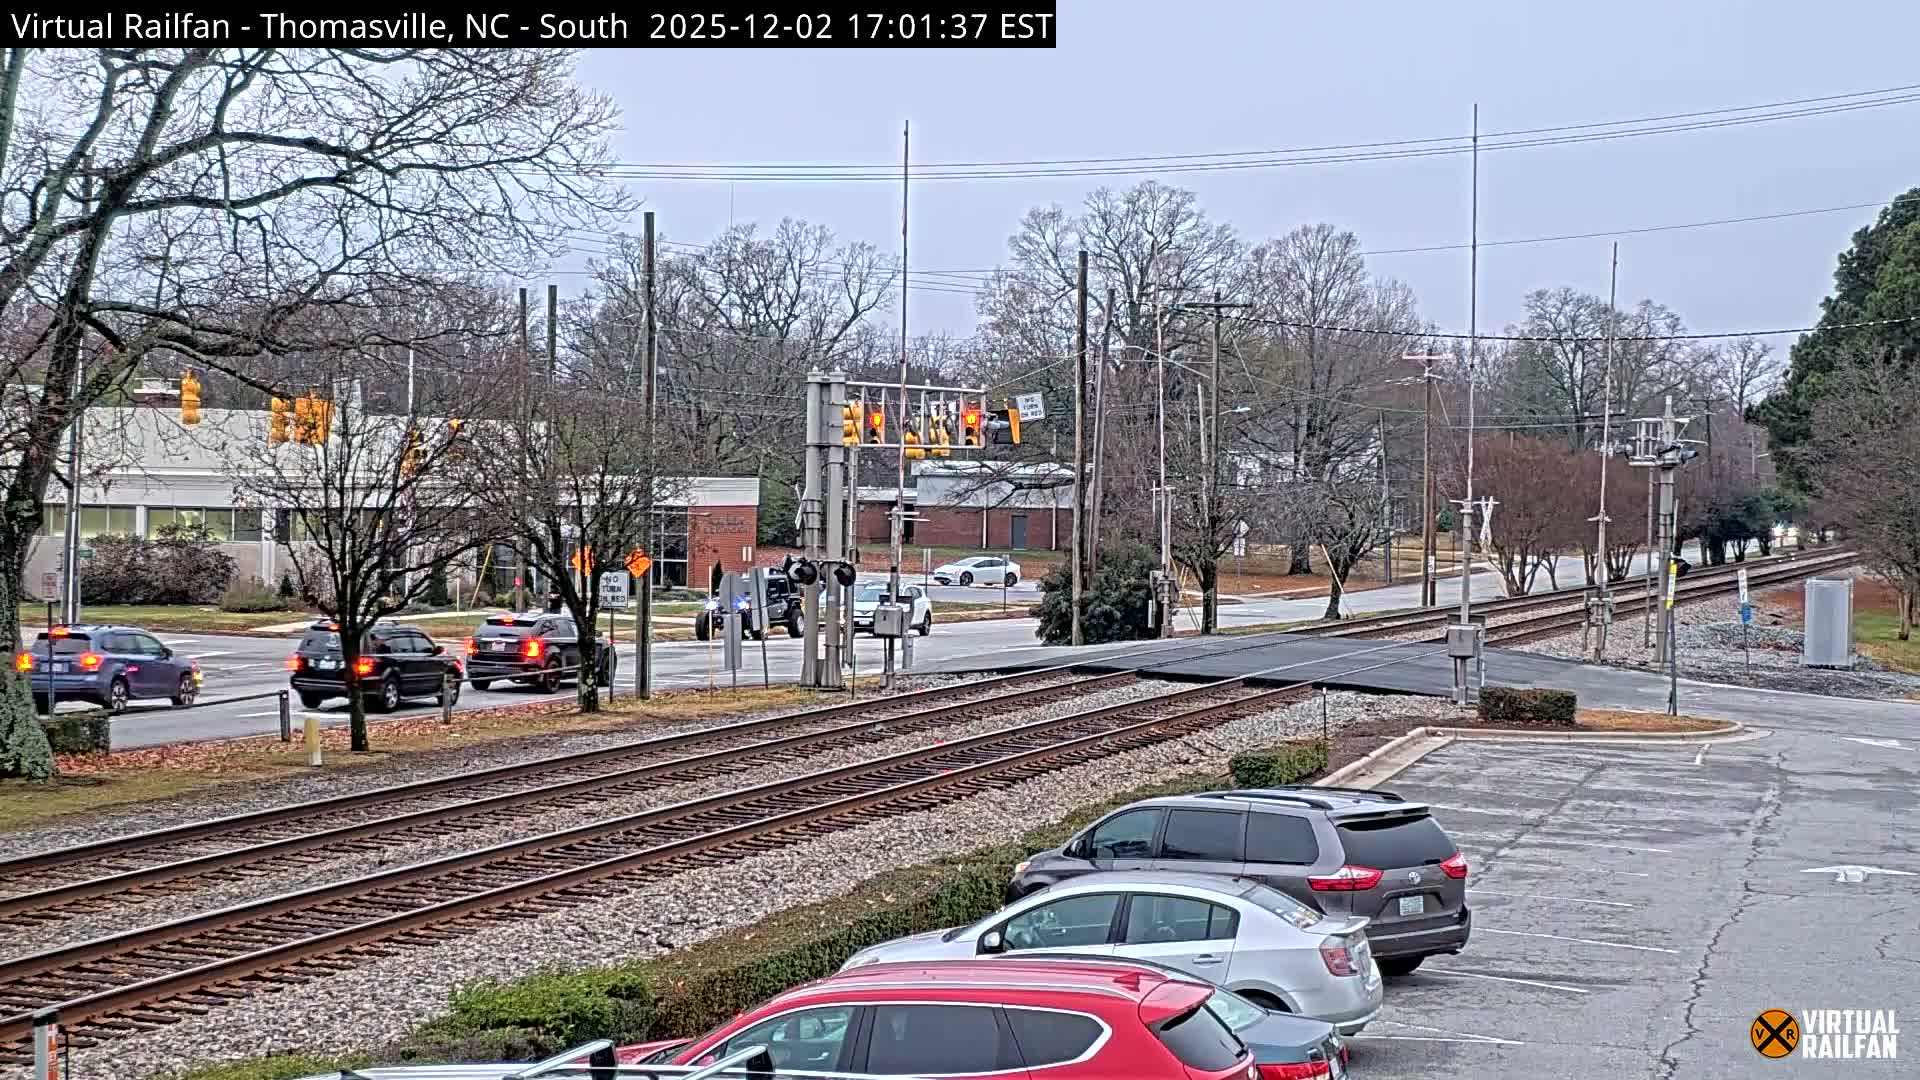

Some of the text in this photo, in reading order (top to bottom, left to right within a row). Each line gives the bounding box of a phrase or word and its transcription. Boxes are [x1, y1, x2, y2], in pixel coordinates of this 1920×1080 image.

[605, 575, 619, 583] NO
[602, 585, 622, 593] TURN
[611, 595, 626, 603] RED
